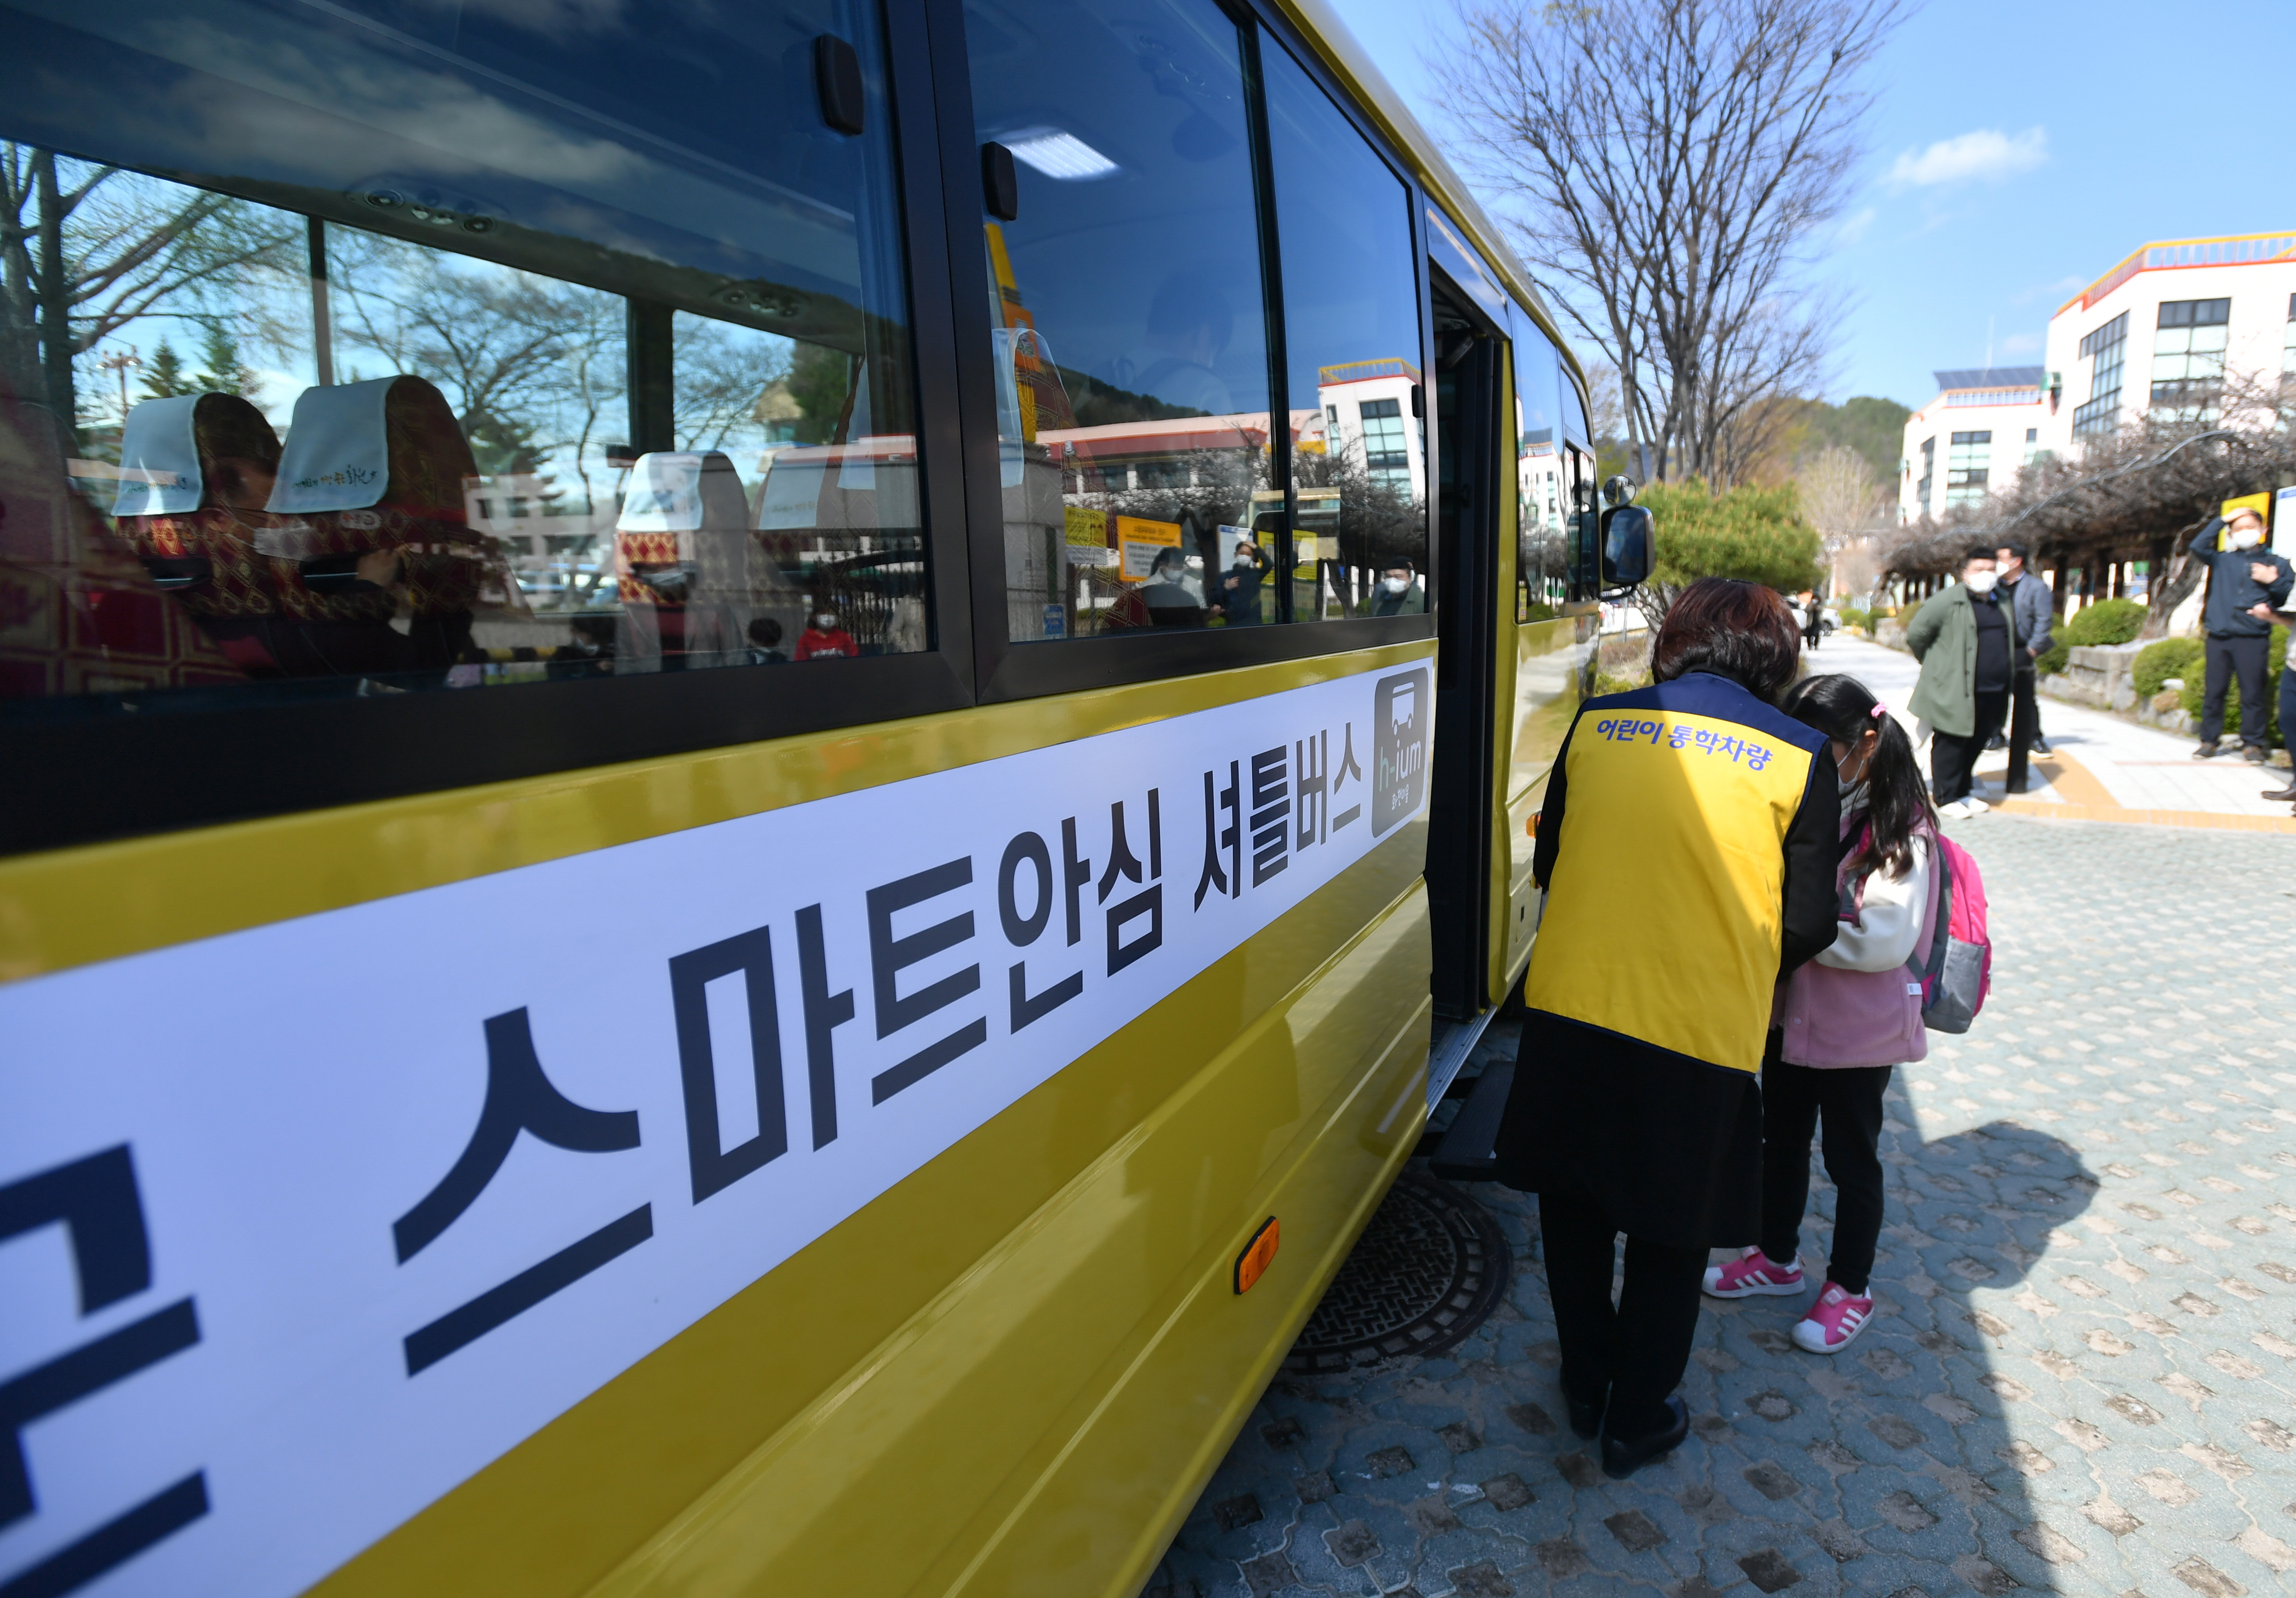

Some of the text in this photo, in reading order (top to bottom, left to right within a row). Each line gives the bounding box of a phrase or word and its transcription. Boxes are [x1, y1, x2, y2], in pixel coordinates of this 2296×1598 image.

[1379, 739, 1421, 792] h-ium
[1597, 719, 1774, 771] 어린이 통학차량
[392, 787, 1163, 1378] 스마트안심
[1194, 722, 1361, 914] 셔틀버스
